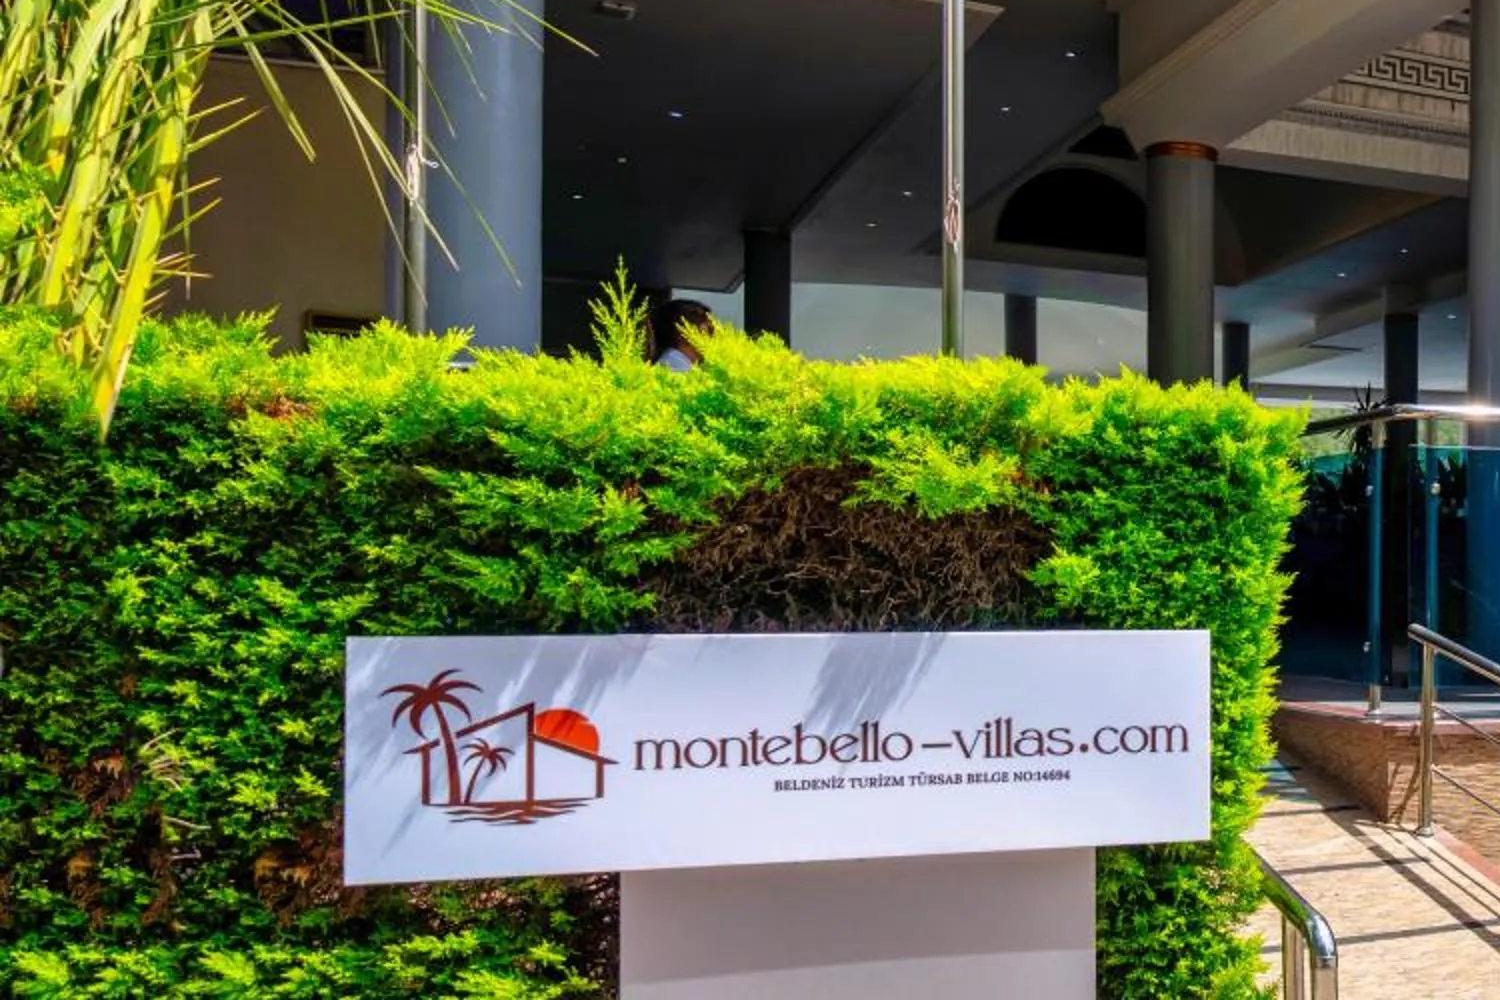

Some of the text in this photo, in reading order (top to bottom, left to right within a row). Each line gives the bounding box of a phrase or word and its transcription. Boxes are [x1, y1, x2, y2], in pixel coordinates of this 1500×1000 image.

[634, 716, 1189, 771] montebello-villas.com
[775, 776, 844, 791] BELDENİZ
[848, 772, 905, 789] TURİZM
[907, 771, 963, 786] TÜRSAB
[966, 771, 1009, 785] BELGE
